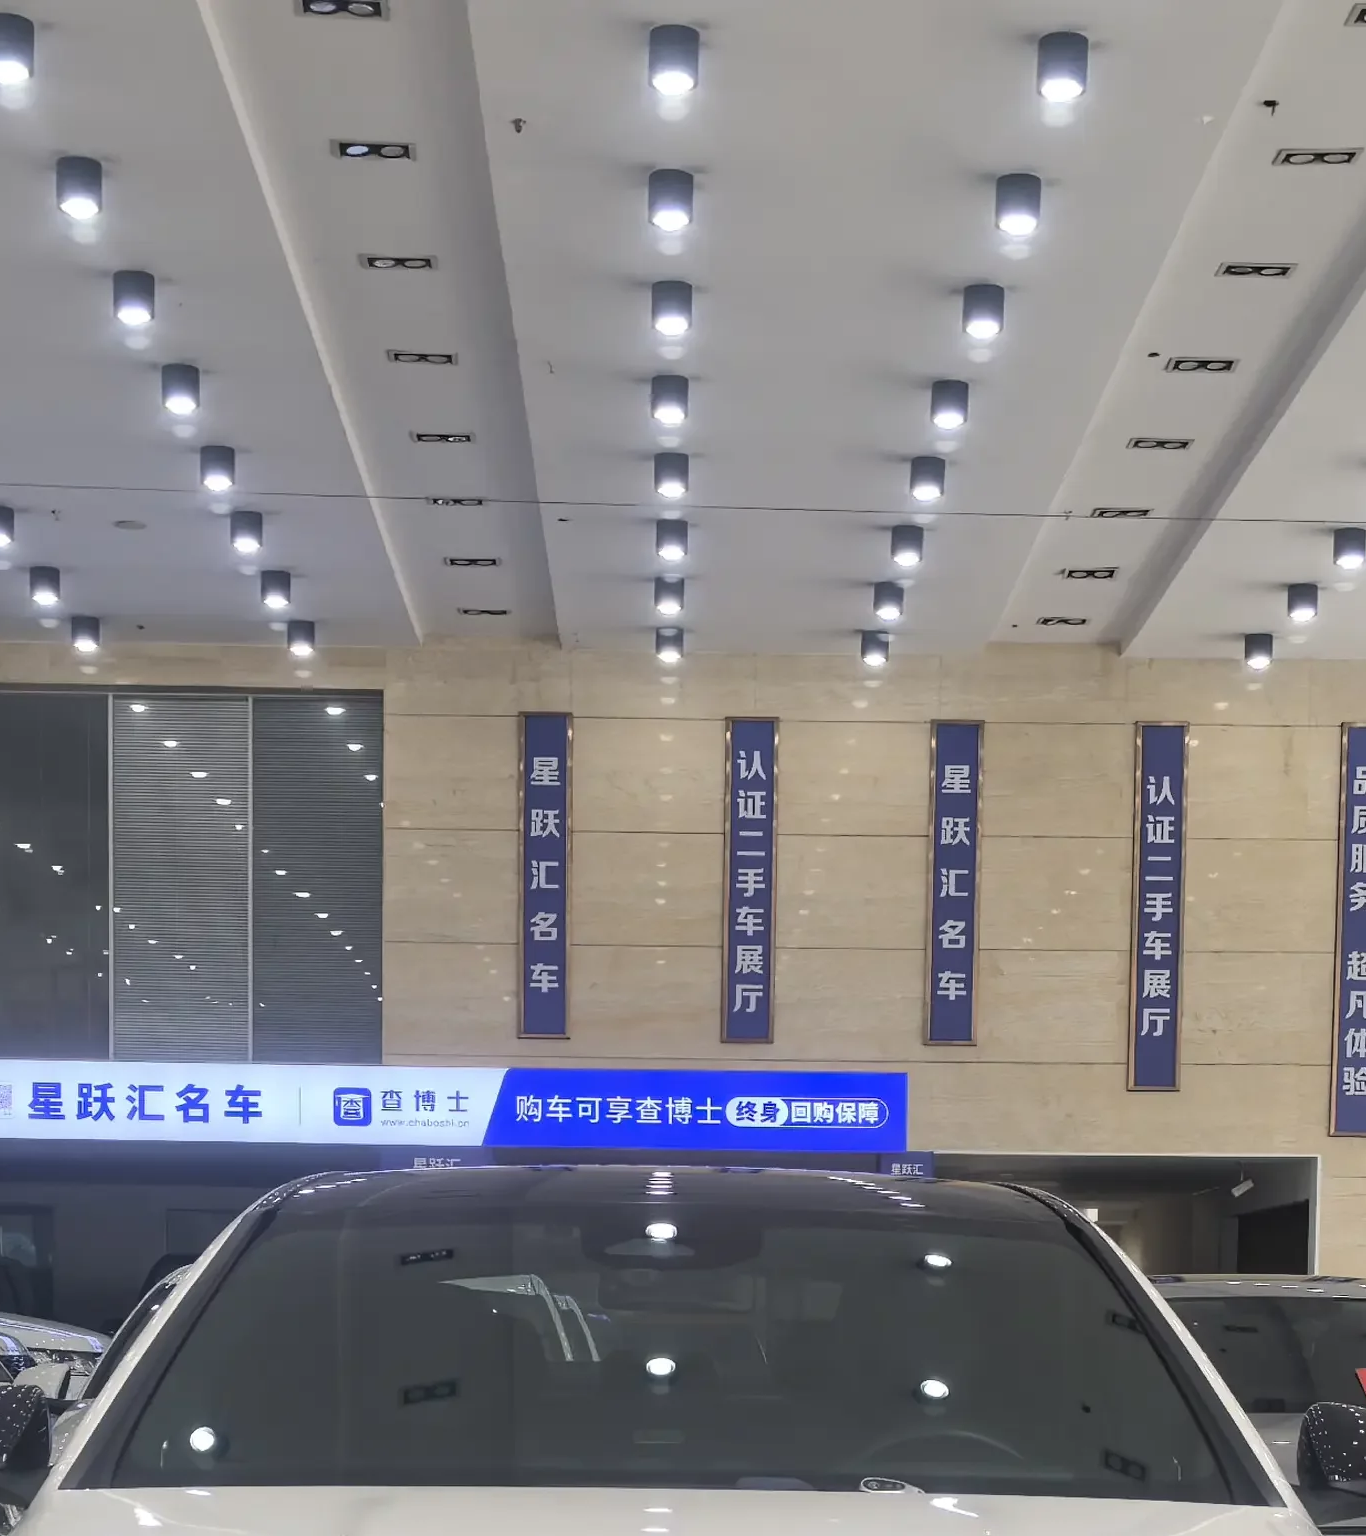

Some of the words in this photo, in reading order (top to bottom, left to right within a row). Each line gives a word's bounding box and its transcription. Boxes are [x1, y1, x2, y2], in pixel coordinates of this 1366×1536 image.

[529, 755, 562, 994] 星跃汇名车
[733, 749, 768, 1015] 认证二手车展厅
[936, 764, 973, 1003] 星跃汇名车
[1140, 774, 1177, 1038] 认证二手车展厅
[27, 1081, 262, 1125] 星跃汇名车
[380, 1089, 470, 1112] 查博士
[890, 1162, 924, 1176] 星跃汇
